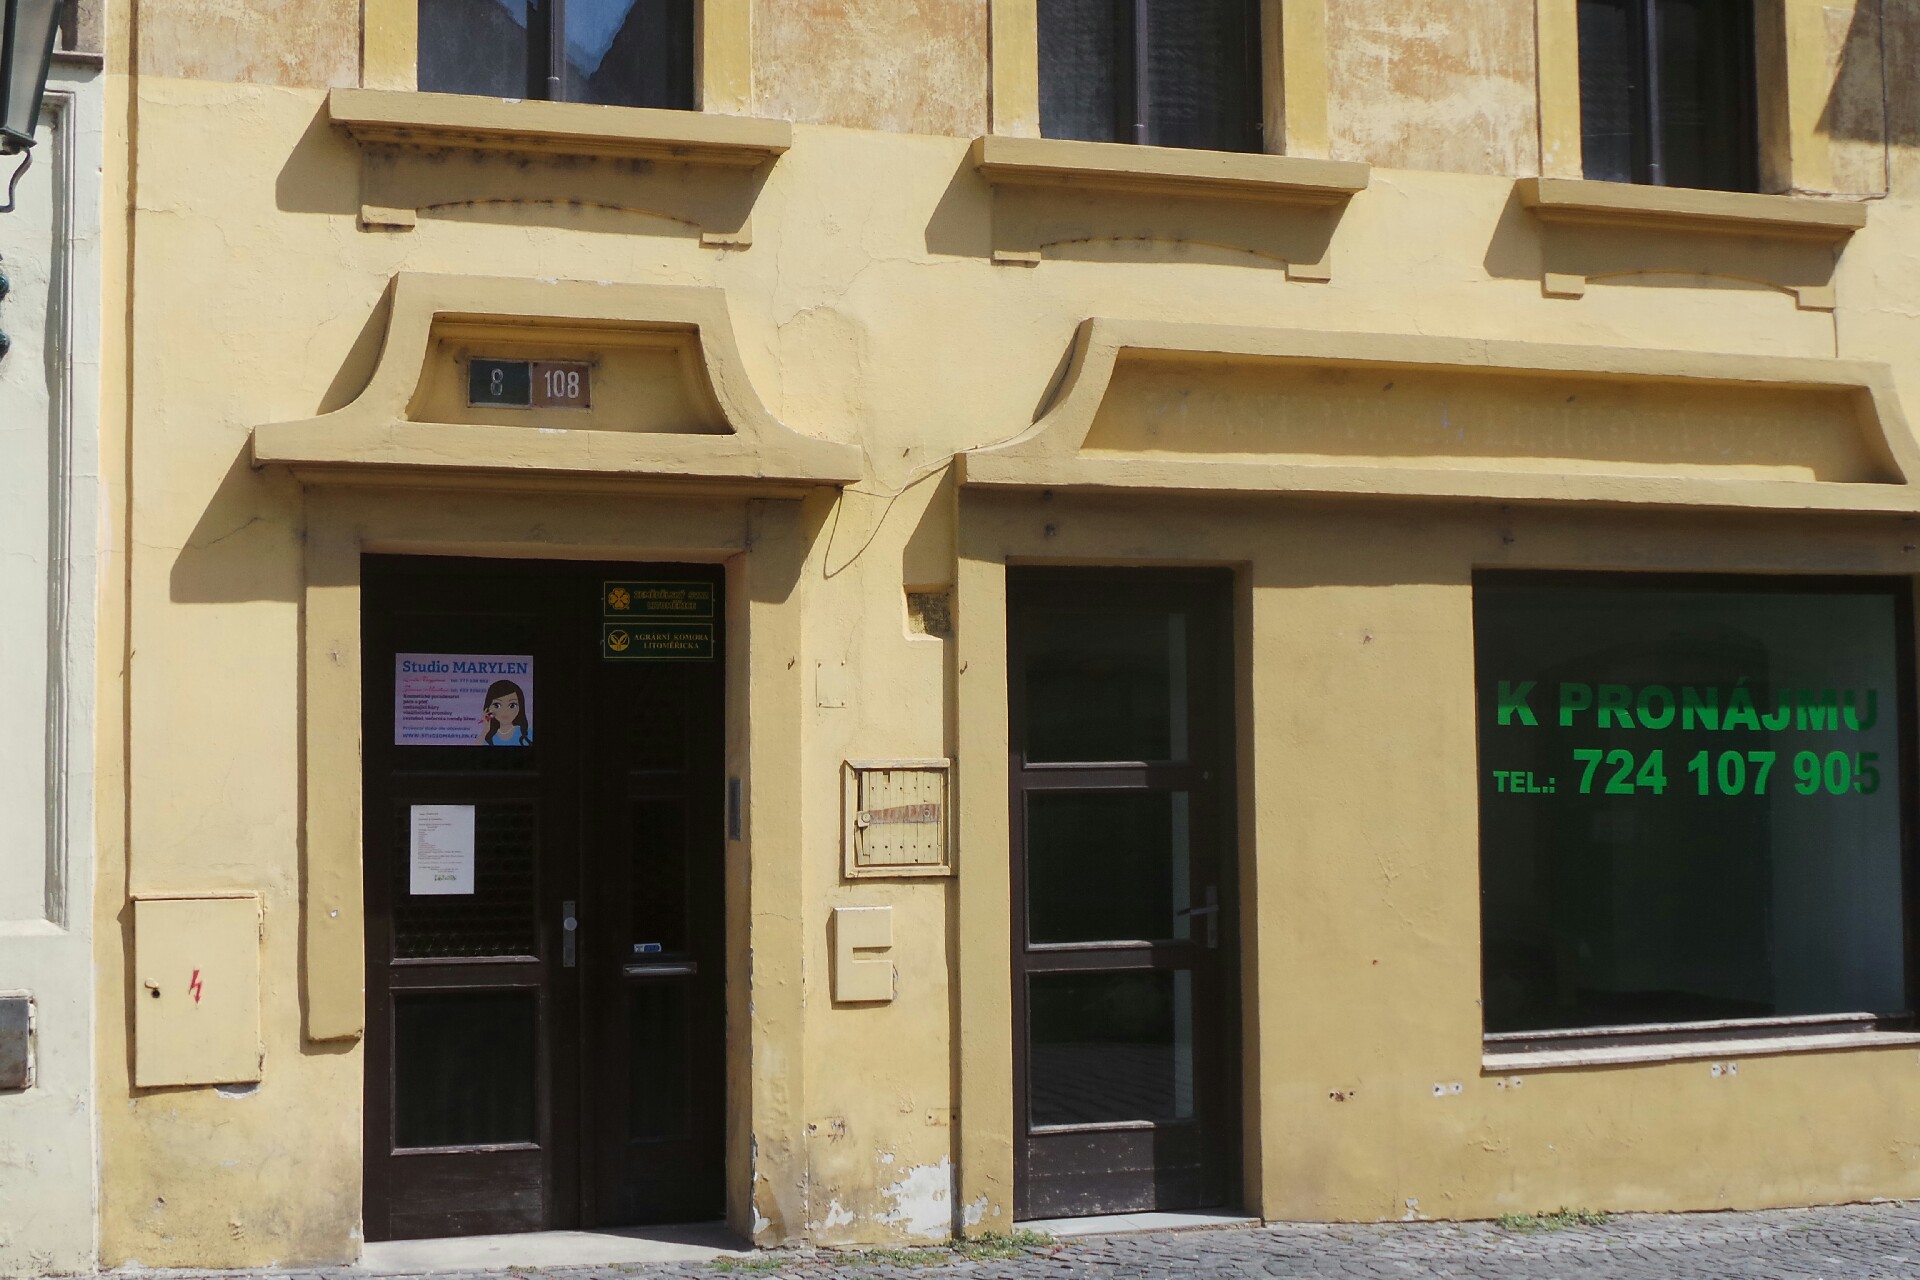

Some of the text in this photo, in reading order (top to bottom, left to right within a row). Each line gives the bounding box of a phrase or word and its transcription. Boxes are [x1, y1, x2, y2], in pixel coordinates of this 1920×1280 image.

[490, 368, 504, 396] 8
[544, 369, 580, 399] 108
[634, 632, 709, 641] AGRÁRNÍ KOMORA
[643, 641, 699, 649] LITOMĚŘICKA
[402, 660, 528, 674] Studio MARYLEN
[1497, 676, 1879, 732] K PRONÁJMU
[1492, 748, 1881, 797] TEL.: 724 107 905
